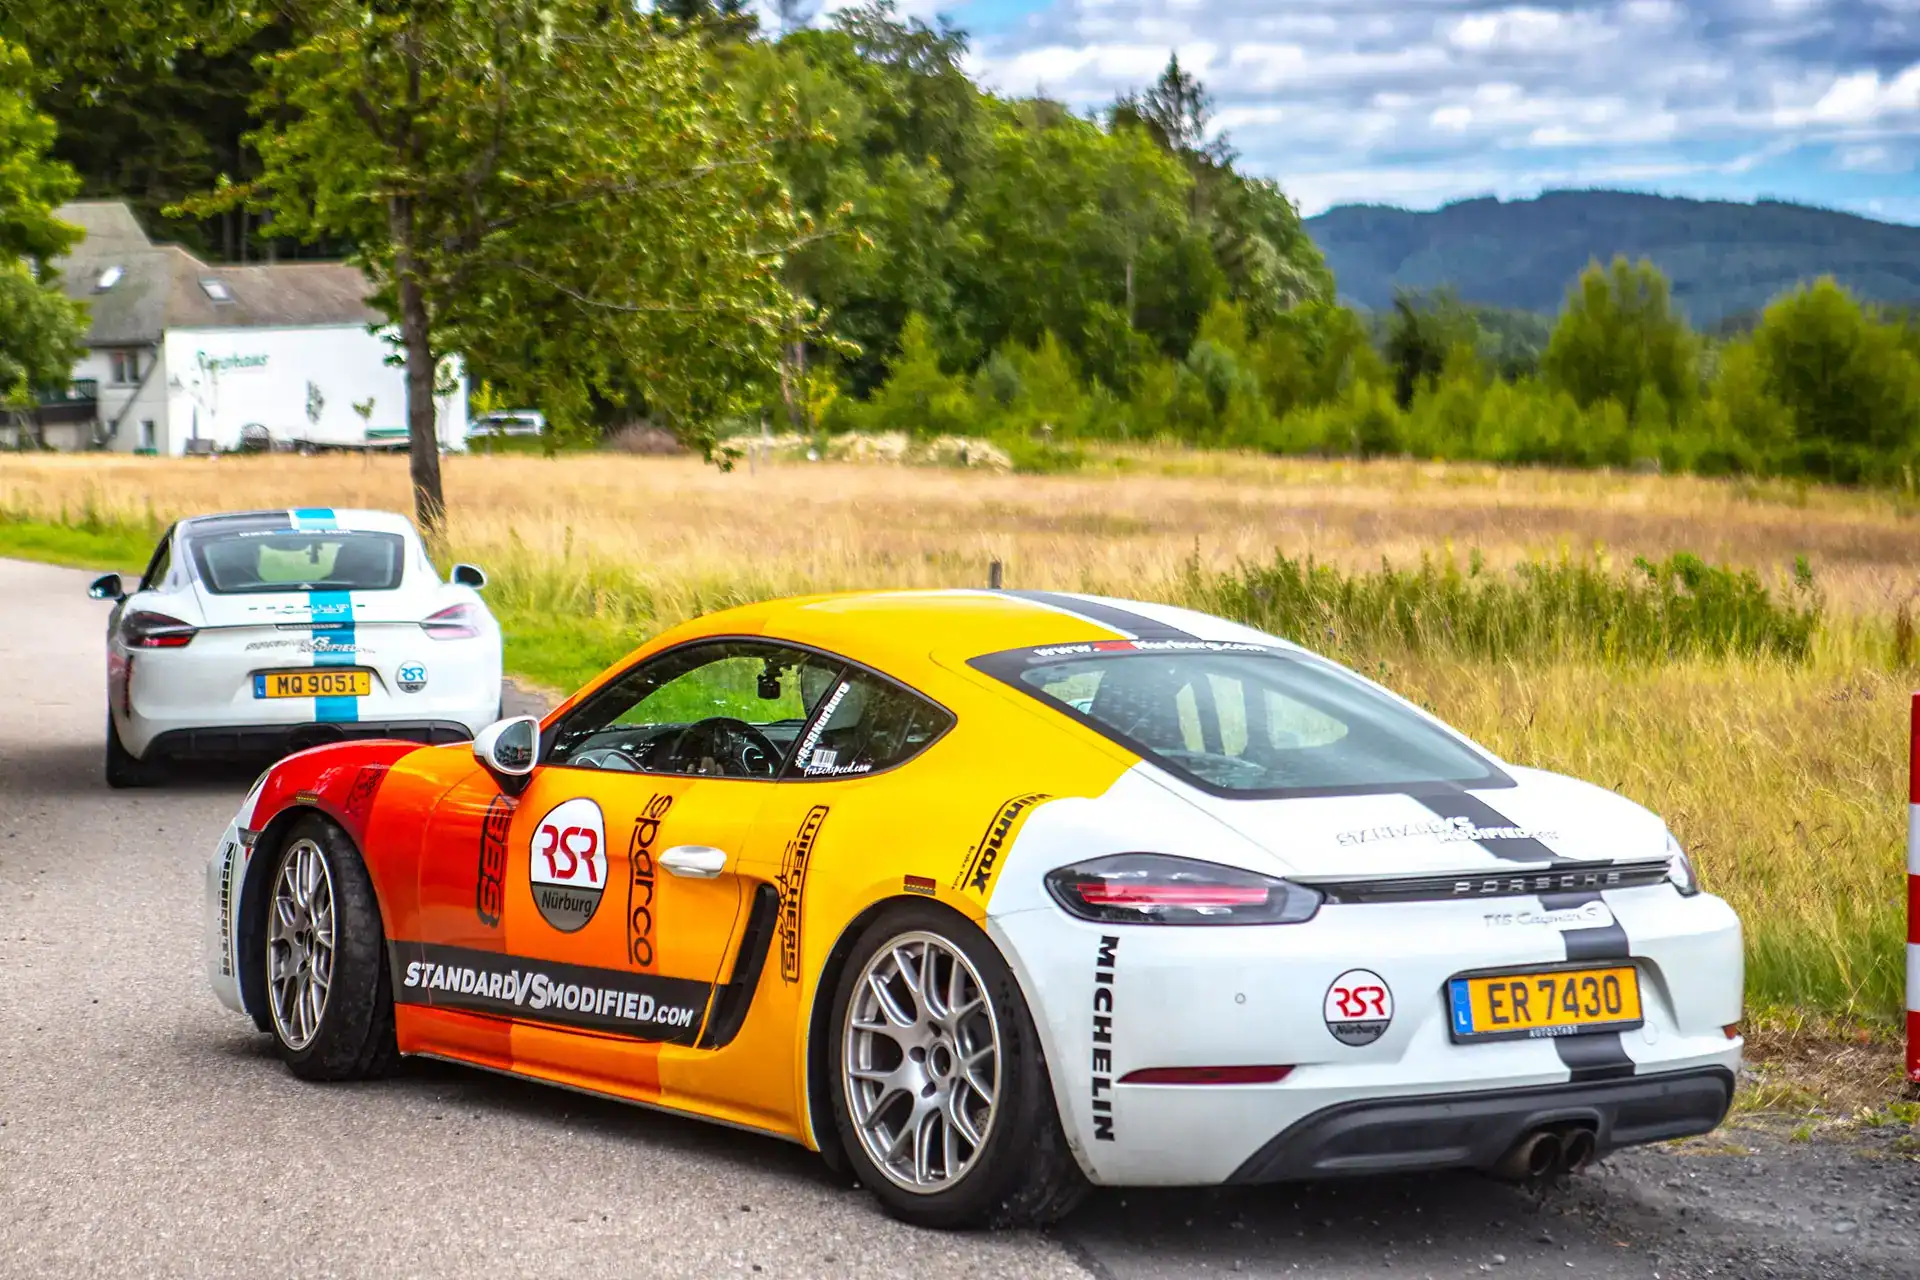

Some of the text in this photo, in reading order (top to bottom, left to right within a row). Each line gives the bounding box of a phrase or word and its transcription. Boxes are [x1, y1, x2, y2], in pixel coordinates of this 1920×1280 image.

[278, 677, 302, 694] MQ
[308, 675, 356, 693] 9051
[541, 825, 598, 882] RSR
[541, 890, 593, 918] Nürburg
[632, 794, 673, 967] sparco
[786, 814, 821, 972] WIECHERS
[1453, 872, 1620, 894] PORSCHE
[1334, 986, 1385, 1017] RSR
[1458, 975, 1621, 1025] L ER 7430
[1092, 935, 1120, 1142] MICHELIN
